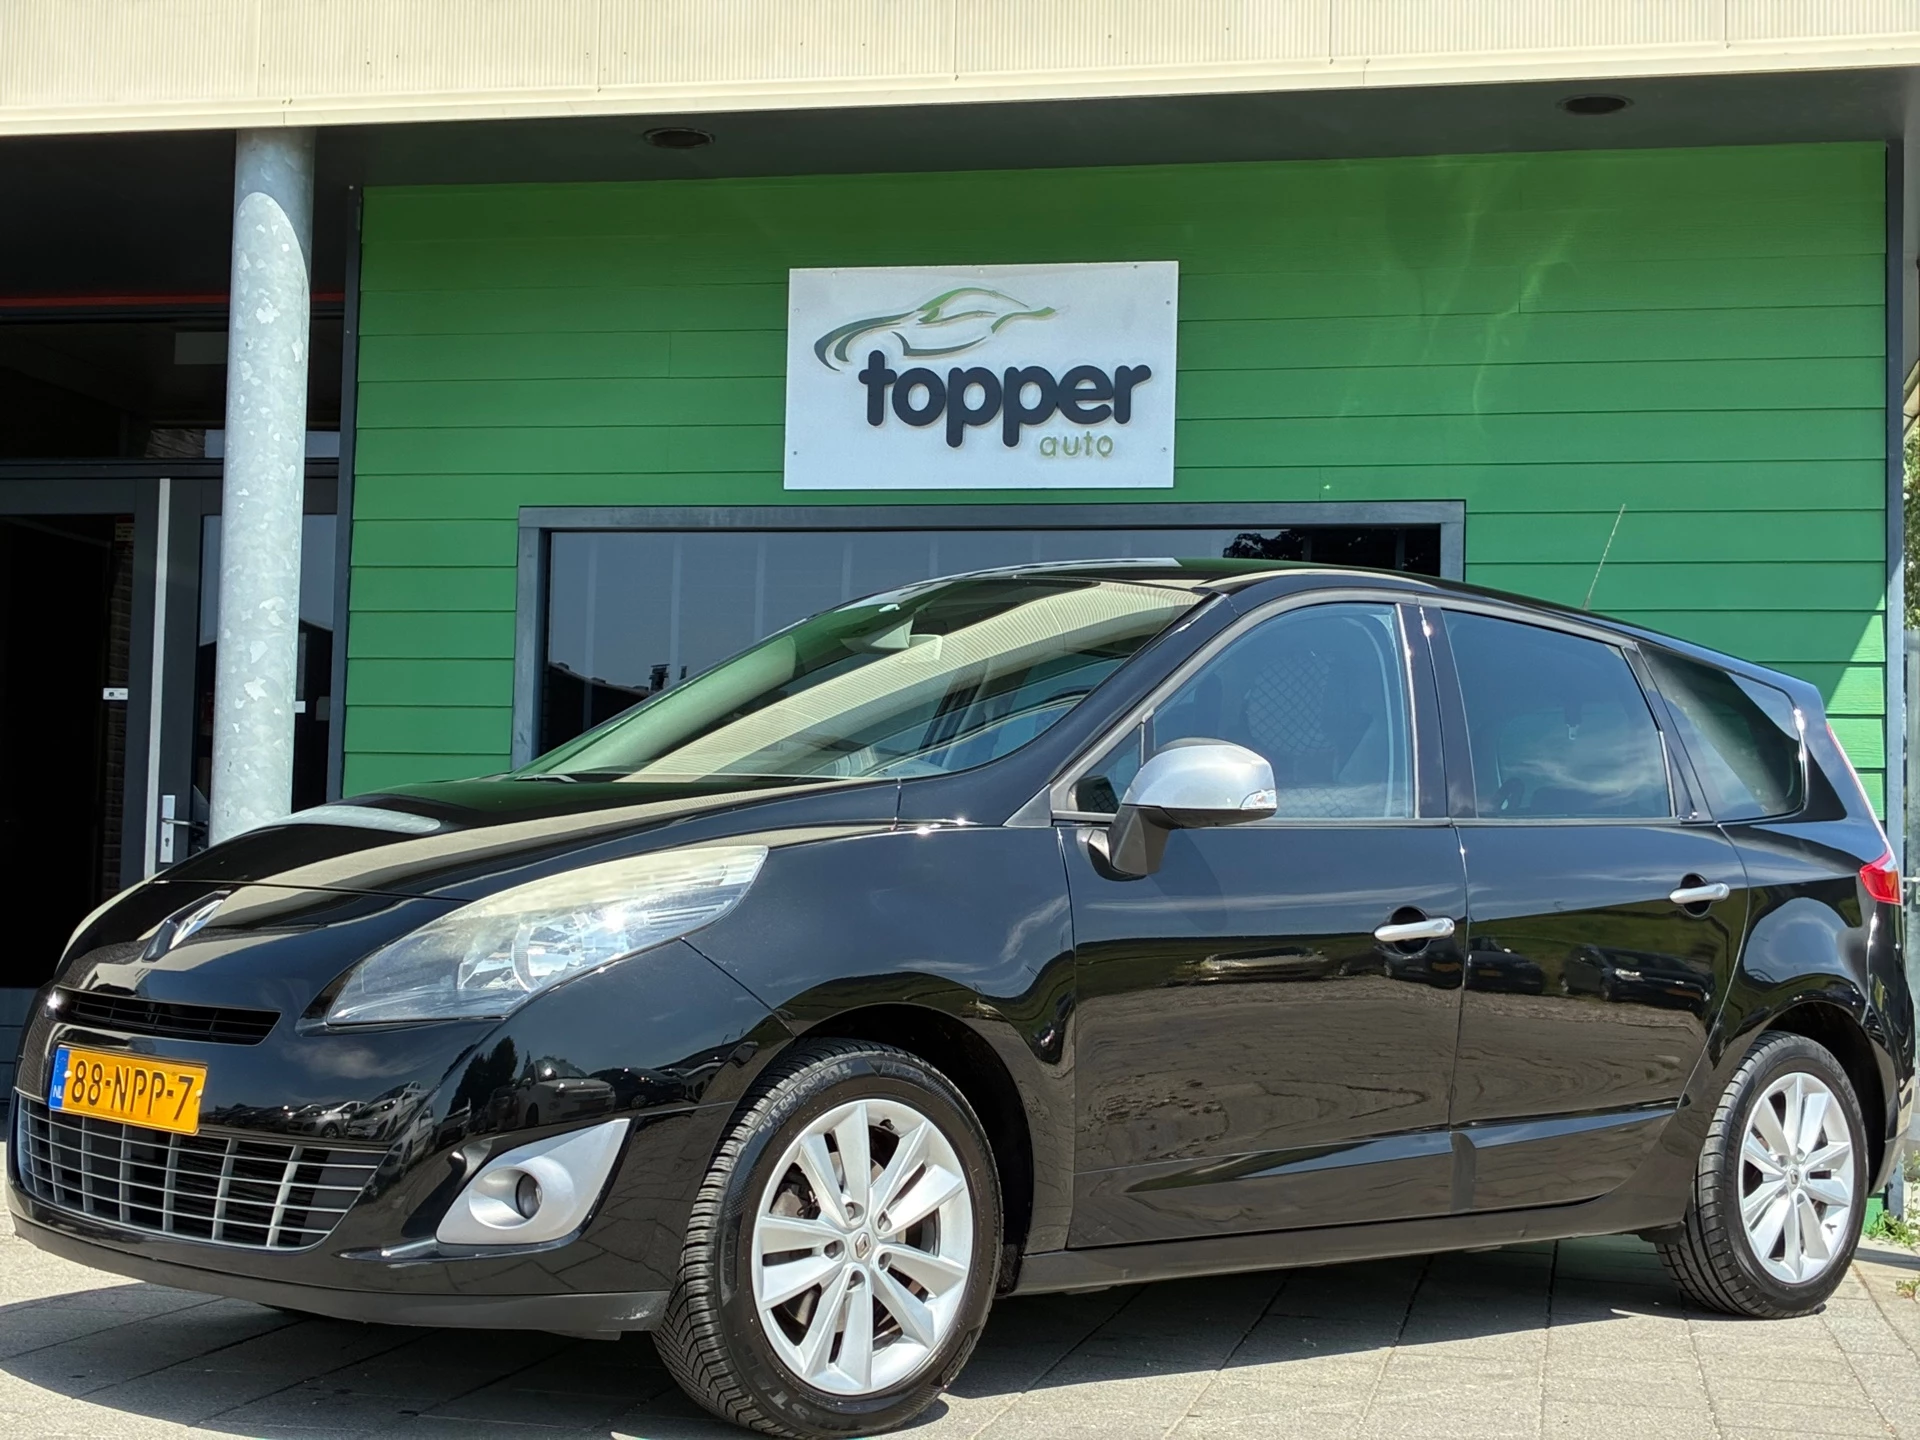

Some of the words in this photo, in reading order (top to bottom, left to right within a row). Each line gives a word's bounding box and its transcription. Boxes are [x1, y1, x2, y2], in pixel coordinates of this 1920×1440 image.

[858, 349, 1152, 448] topper
[1039, 430, 1114, 458] auto
[71, 1060, 195, 1122] 88-NPP-7
